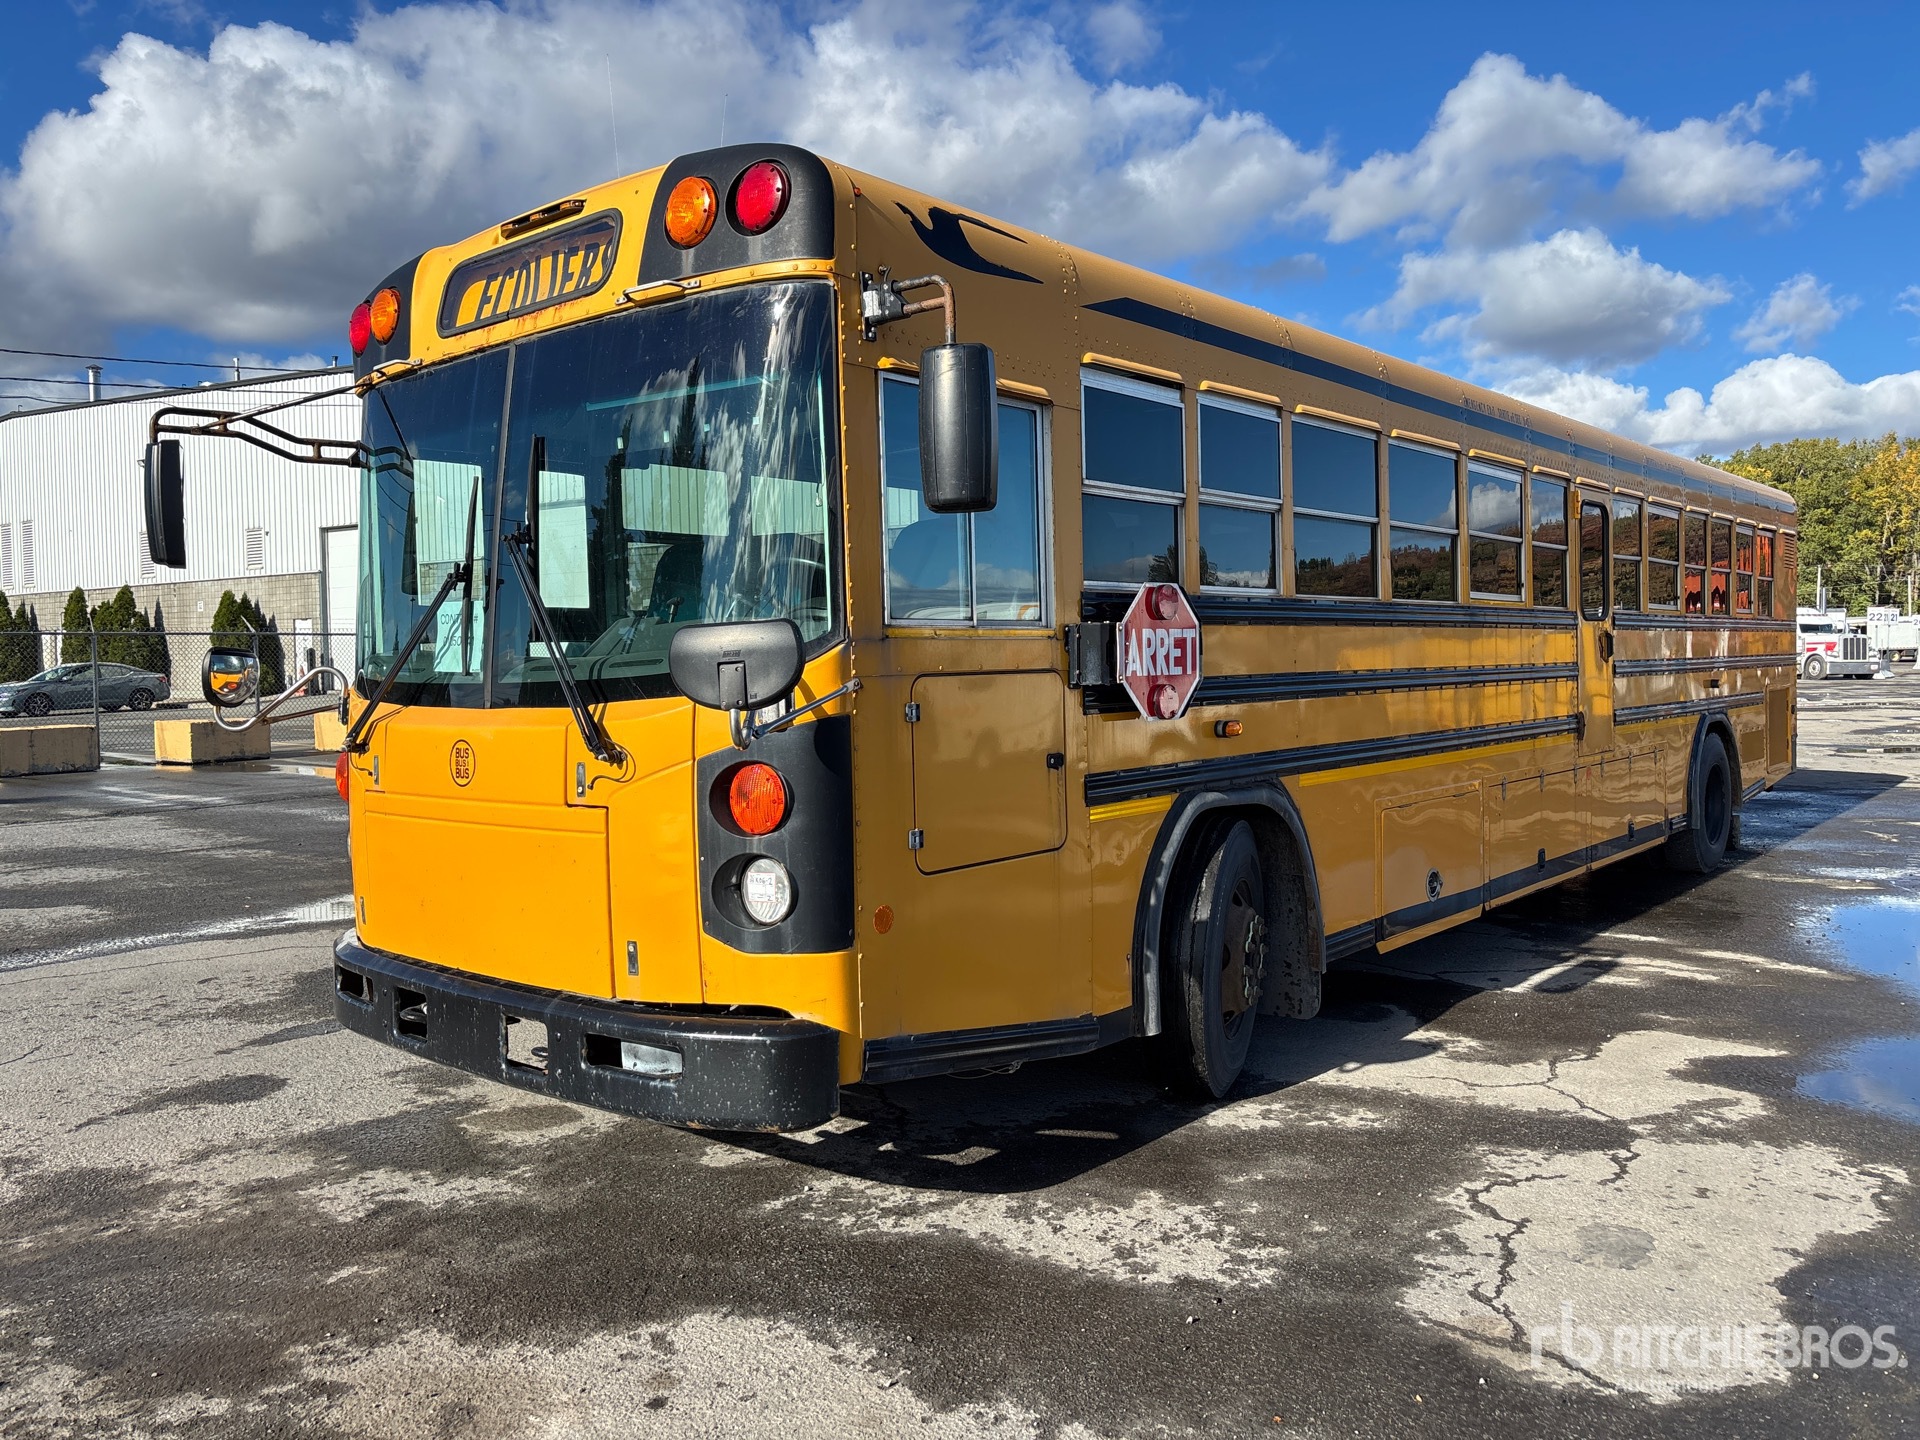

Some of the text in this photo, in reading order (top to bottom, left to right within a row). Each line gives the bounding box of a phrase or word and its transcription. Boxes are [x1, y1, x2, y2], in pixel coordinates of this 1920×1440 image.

[1869, 612, 1883, 621] 22
[1126, 628, 1196, 677] ARRET
[455, 747, 470, 759] BUS
[455, 767, 470, 779] BUS
